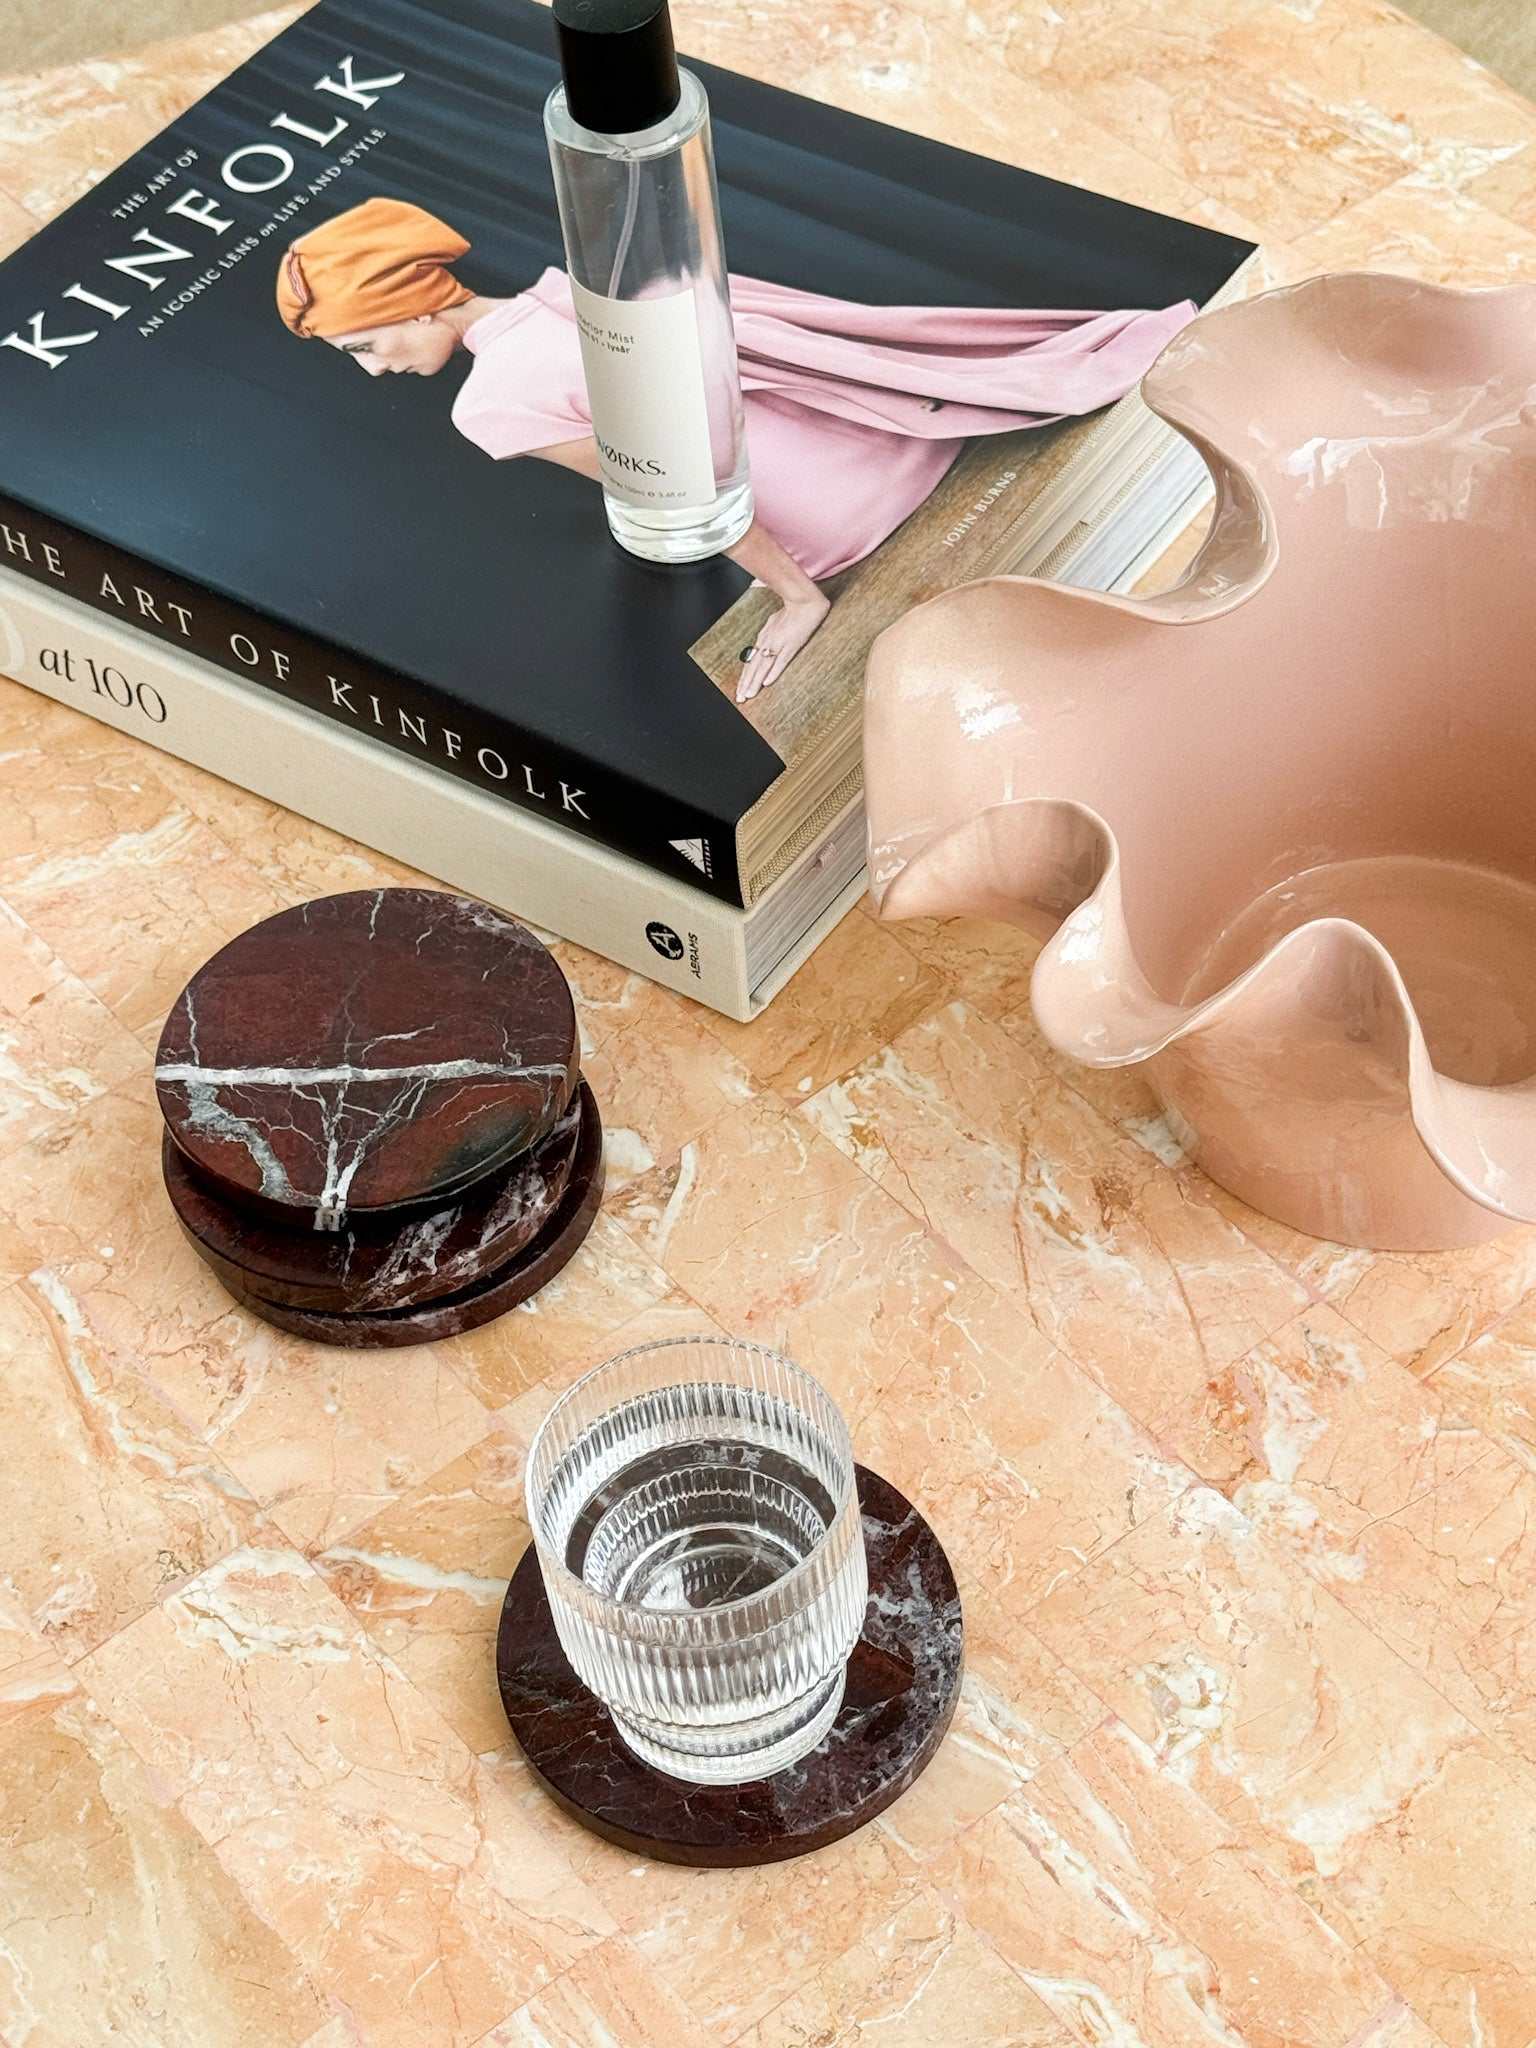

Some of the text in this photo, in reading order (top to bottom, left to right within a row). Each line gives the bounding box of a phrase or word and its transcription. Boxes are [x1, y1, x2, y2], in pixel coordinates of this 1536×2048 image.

[0, 55, 405, 369] KINFOLK
[112, 148, 199, 219] THE ART OF
[138, 128, 387, 338] AN ICONIC LENS on LIFE AND STYLE
[942, 471, 1017, 548] JOHN BURNS
[0, 523, 591, 820] HE ART OF KINFOLK
[40, 648, 167, 723] at 100
